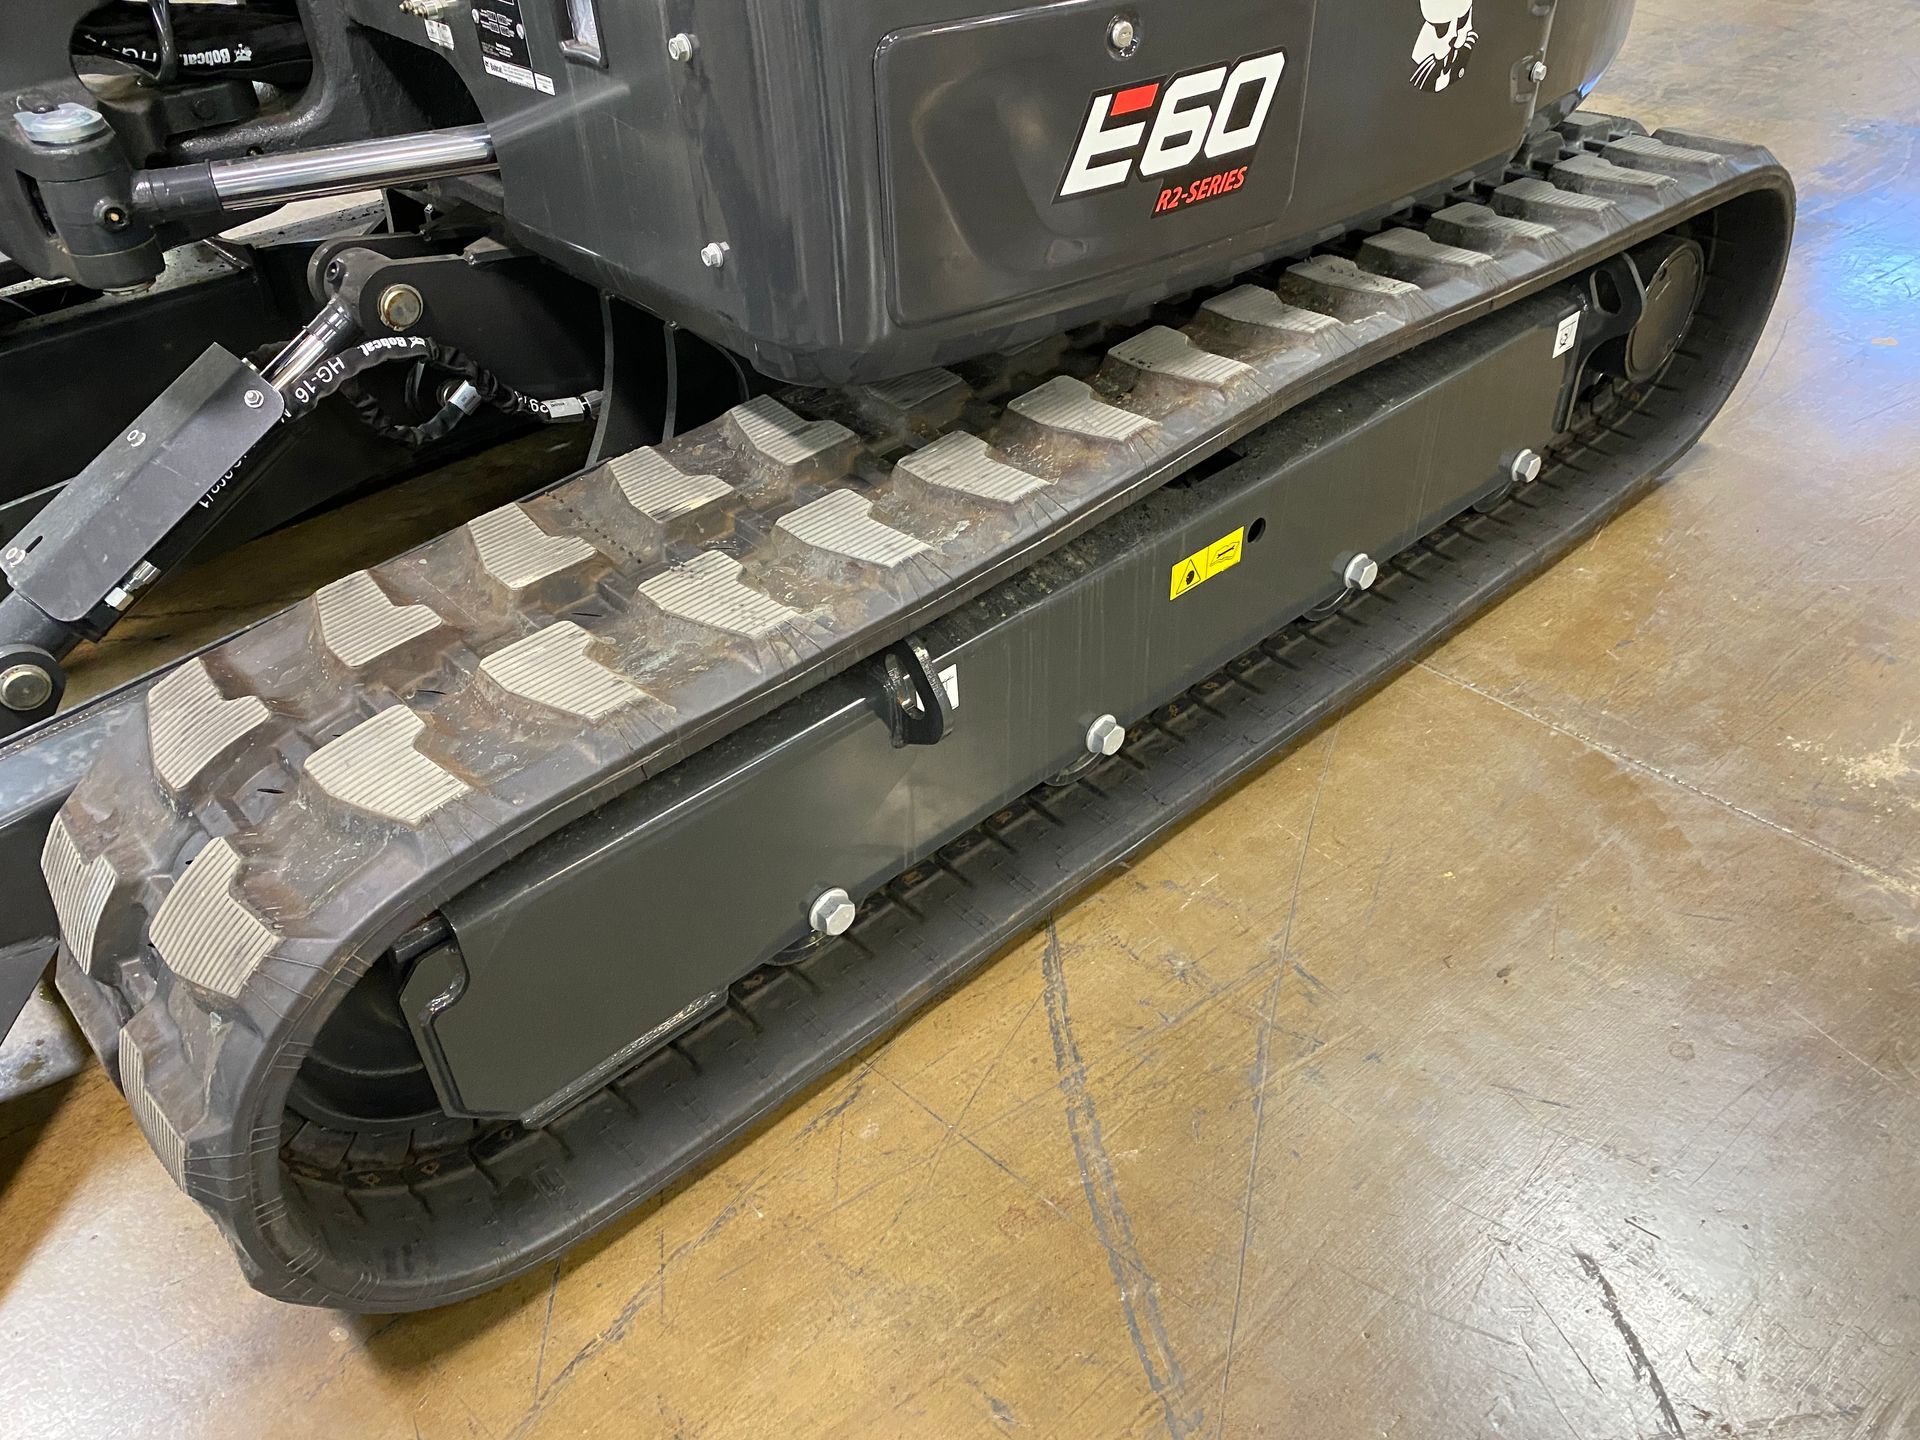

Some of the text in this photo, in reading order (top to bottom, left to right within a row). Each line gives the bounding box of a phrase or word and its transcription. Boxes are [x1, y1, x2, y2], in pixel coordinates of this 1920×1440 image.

[1060, 51, 1286, 196] E60
[1155, 166, 1248, 212] R2-SERIES
[294, 356, 346, 403] HG-16
